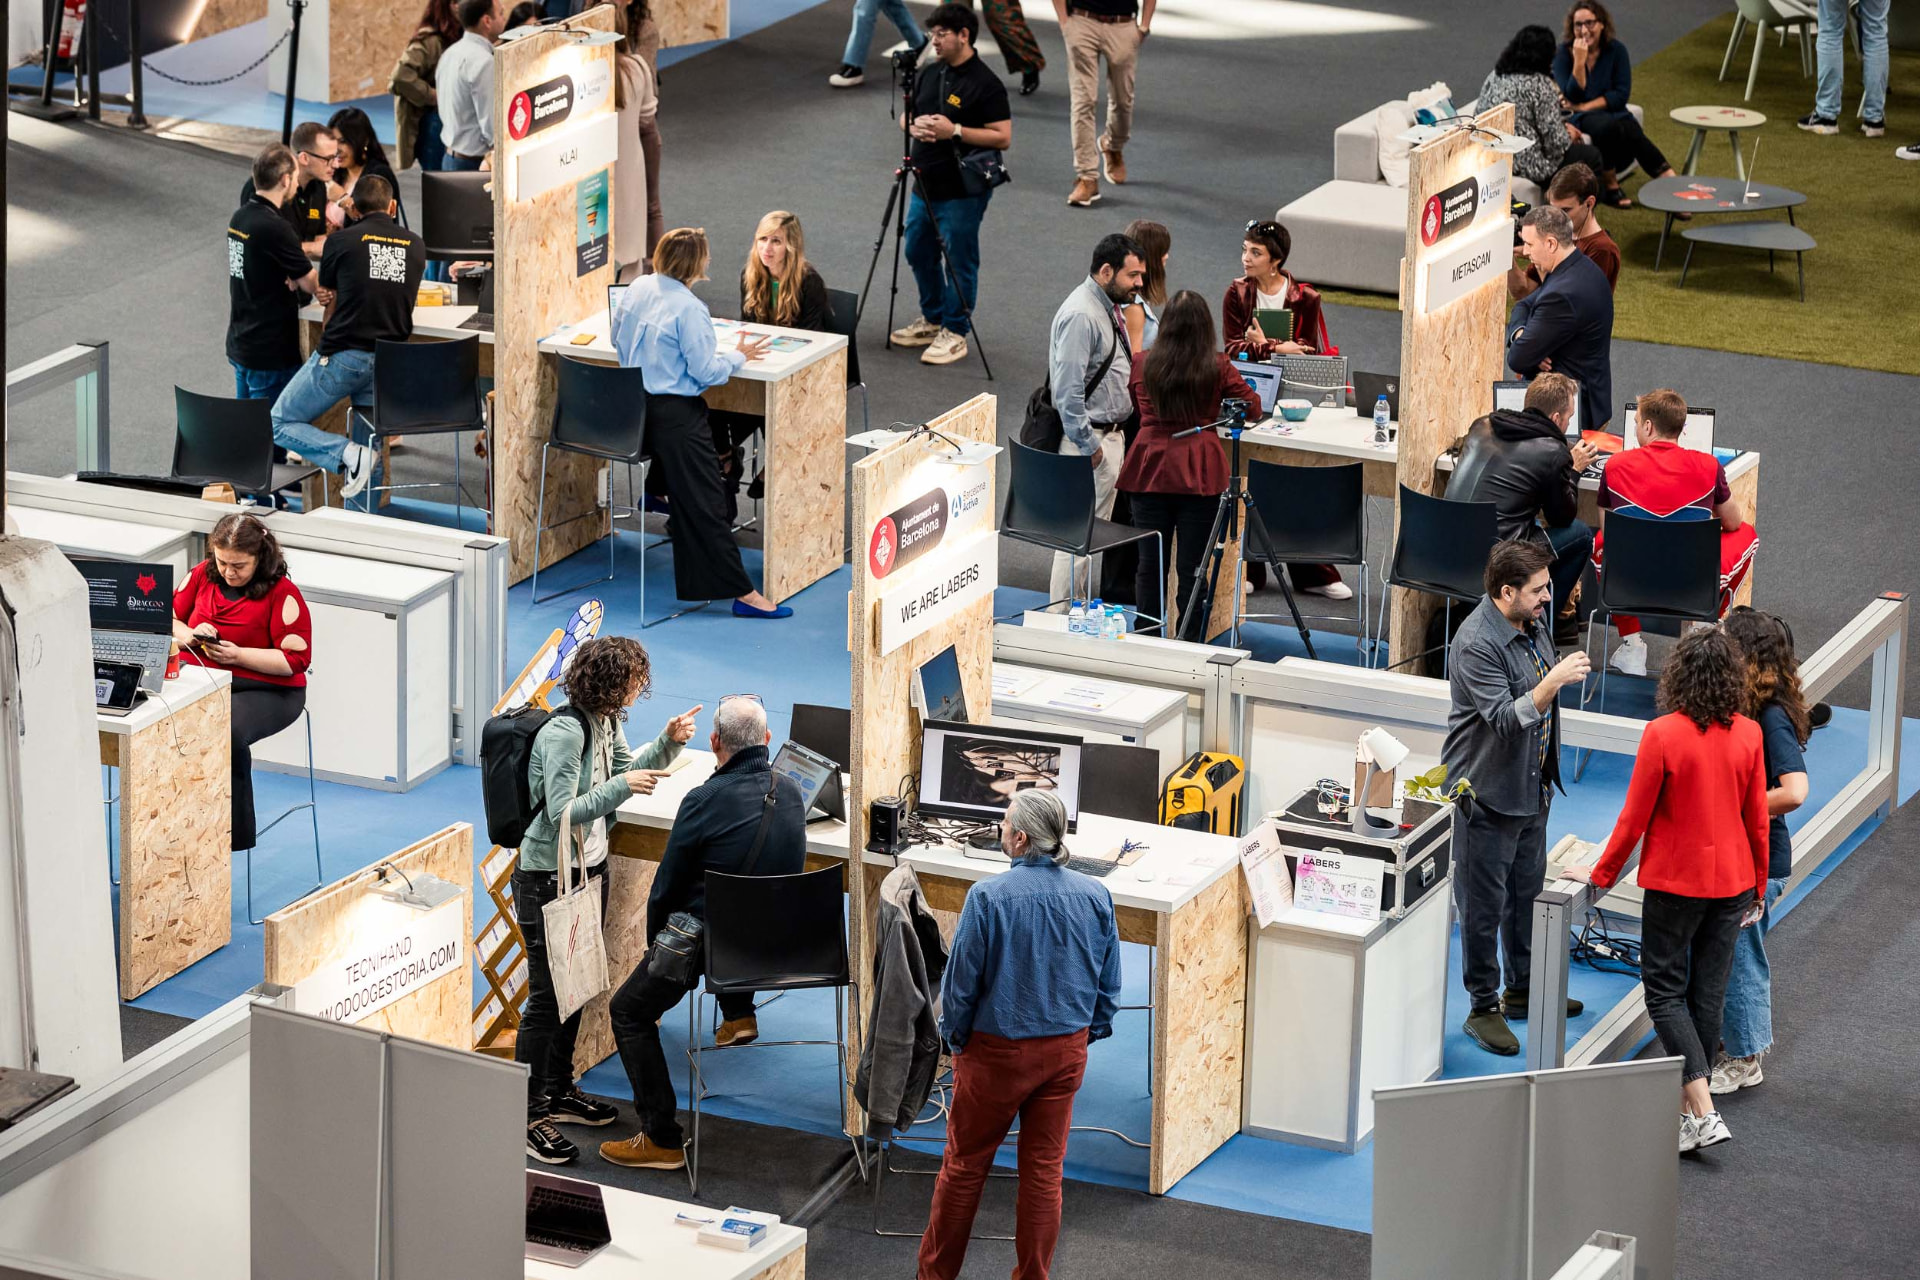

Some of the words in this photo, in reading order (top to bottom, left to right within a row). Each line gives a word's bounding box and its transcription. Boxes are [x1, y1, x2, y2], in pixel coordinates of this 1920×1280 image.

[534, 97, 568, 120] Barcelona
[560, 147, 578, 167] KLAI
[1445, 190, 1468, 211] Ajuntament
[1467, 187, 1473, 199] de
[1444, 202, 1472, 225] Barcelona
[1452, 250, 1492, 284] METASCAN
[963, 481, 986, 501] Barcelona
[963, 497, 979, 513] Activa
[902, 508, 932, 533] Ajuntament
[932, 501, 940, 514] de
[901, 518, 939, 549] Barcelona
[901, 600, 917, 623] WE
[919, 587, 939, 614] ARE
[941, 563, 979, 600] LABERS
[1242, 840, 1260, 857] LABERS
[1302, 857, 1341, 870] LABERS
[345, 936, 412, 985] TECNIHAND
[319, 941, 456, 1021] WODOOGESTORIA.COM
